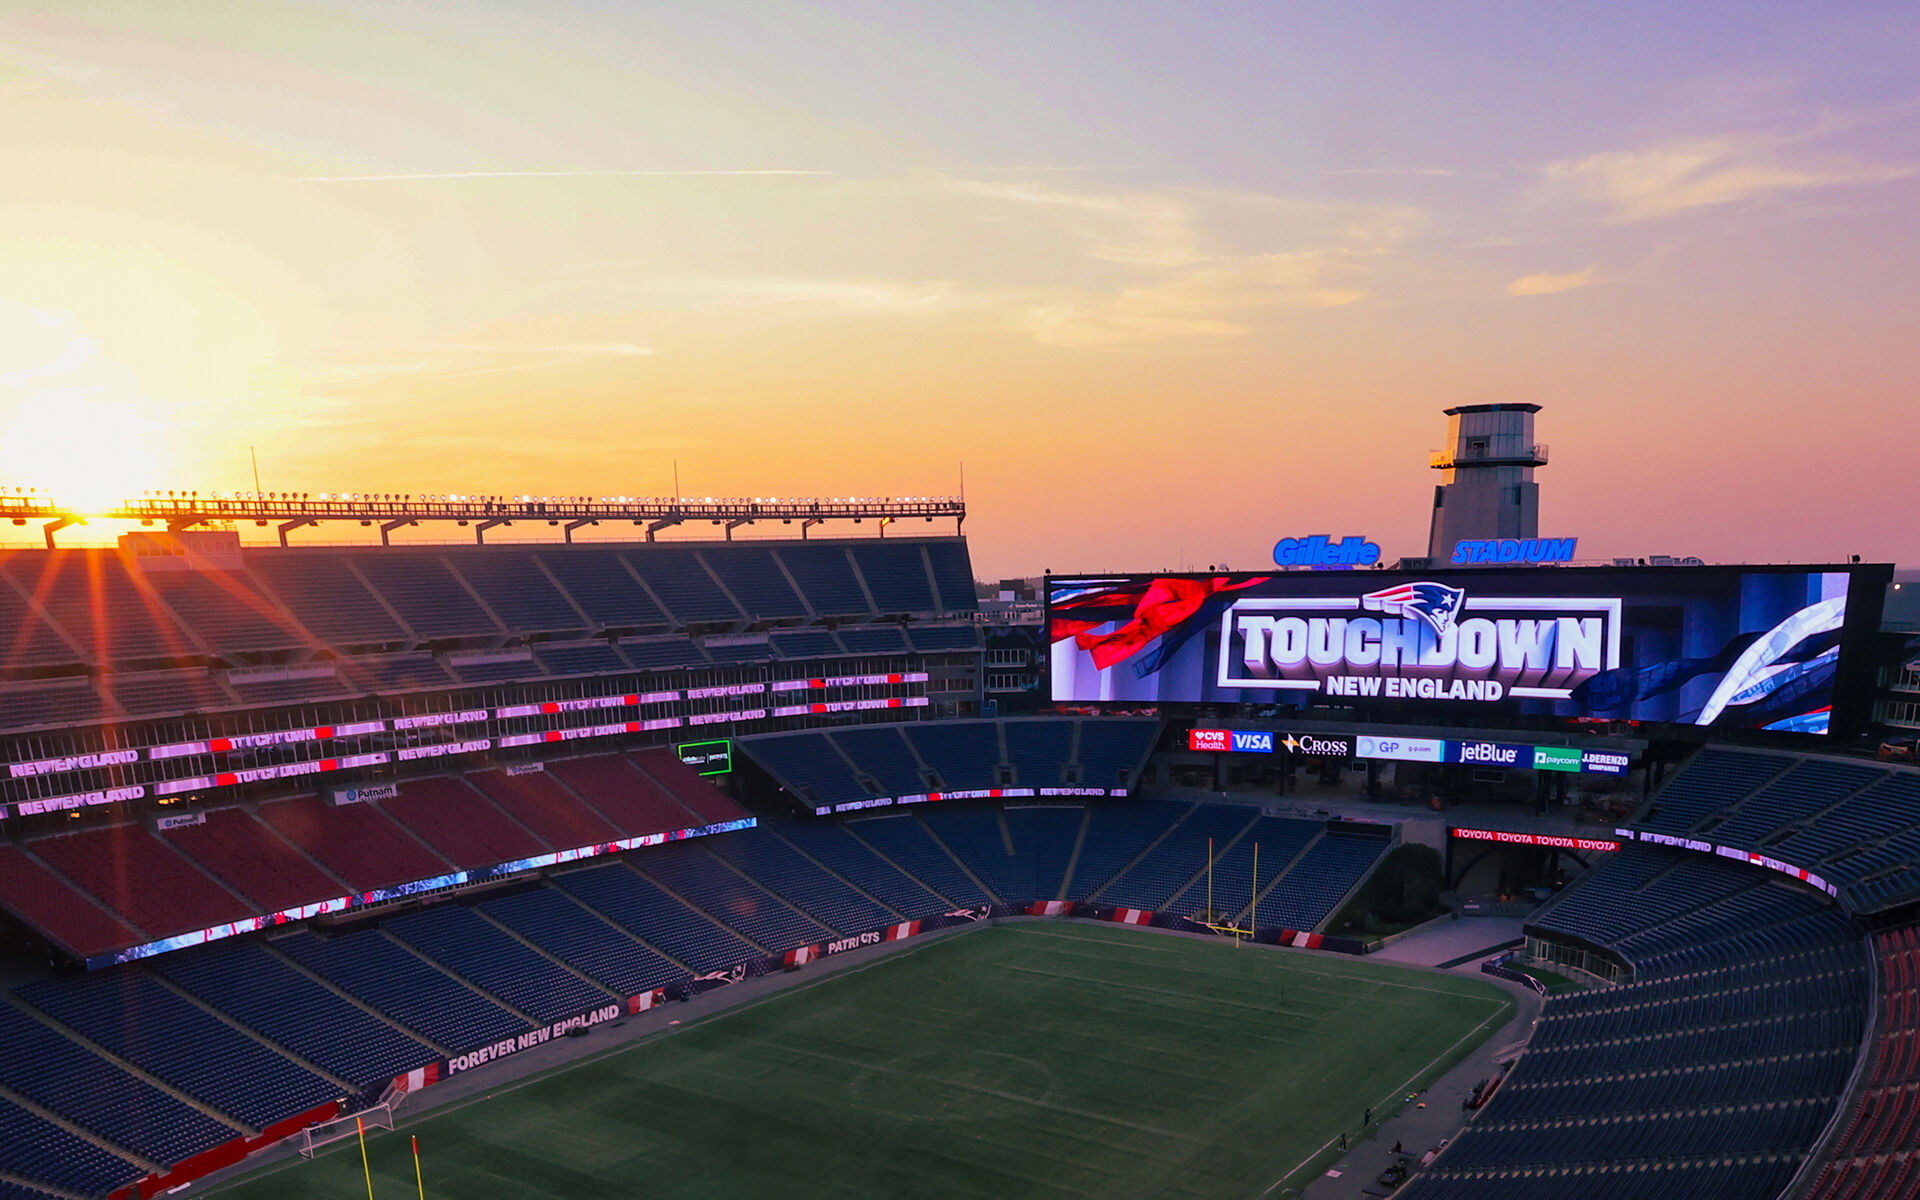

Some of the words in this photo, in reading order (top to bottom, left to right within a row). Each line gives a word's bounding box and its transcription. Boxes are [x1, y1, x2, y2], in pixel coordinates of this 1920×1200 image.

[1273, 534, 1380, 565] Gillette
[1452, 538, 1577, 565] STADIUM
[1237, 615, 1603, 675] TOUCHDOWN
[1326, 675, 1382, 697] NEW
[1385, 677, 1503, 702] ENGLAND
[1204, 731, 1225, 741] CVS
[1232, 733, 1272, 750] VISA
[9, 760, 54, 778] NEW
[55, 749, 139, 772] ENGLAND
[1459, 742, 1516, 763] jetBlue
[18, 798, 62, 817] NEW
[62, 786, 145, 810] ENGLAND
[358, 787, 392, 798] Putnam
[1457, 828, 1493, 840] TOYOTA
[1496, 832, 1533, 844] TOYOTA
[1536, 836, 1573, 848] TOYOTA
[1577, 839, 1615, 851] TOYOTA
[448, 1037, 517, 1076] FOREVER
[518, 1025, 551, 1050] NEW
[553, 1004, 620, 1038] ENGLAND
